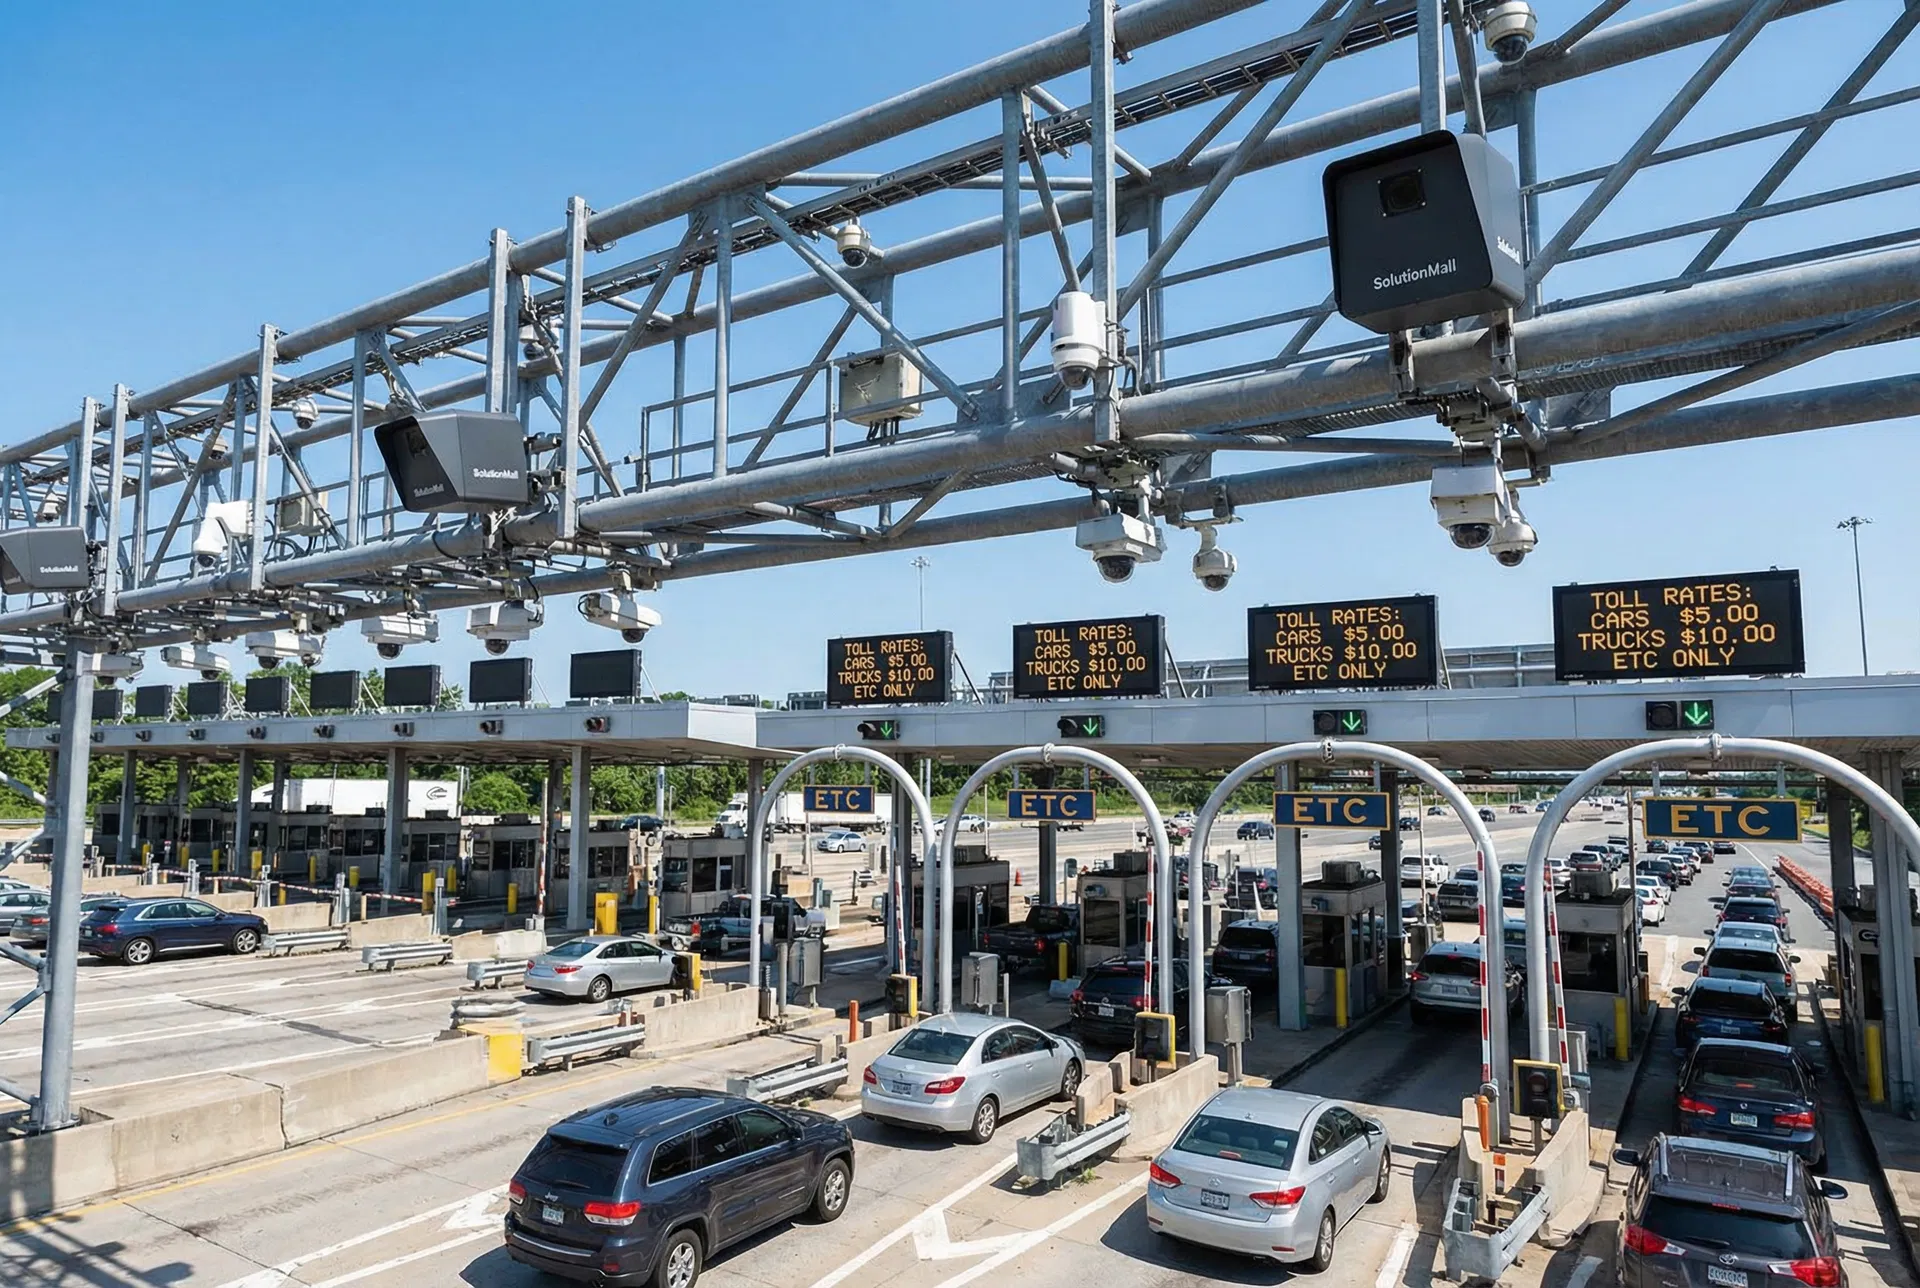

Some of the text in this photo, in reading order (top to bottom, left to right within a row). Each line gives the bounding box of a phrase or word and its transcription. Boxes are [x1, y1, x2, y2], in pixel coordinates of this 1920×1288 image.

[1373, 258, 1456, 290] SolutionMall
[1591, 584, 1751, 609] TOLL RATES:
[1276, 607, 1400, 628] TOLL RATES:
[1591, 604, 1758, 630] CARS $5.00
[1035, 624, 1133, 643] TOLL RATES:
[1276, 624, 1404, 646] CARS $5.00
[1578, 624, 1775, 650] TRUCKS $10.00
[845, 639, 924, 656] TOLL RATES:
[1035, 640, 1136, 659] CARS $5.00
[1266, 642, 1416, 664] TRUCKS $10.00
[1613, 647, 1735, 669] ETC ONLY
[845, 653, 927, 670] CARS $5.00
[1026, 657, 1145, 675] TRUCKS $10.00
[1294, 662, 1386, 681] ETC ONLY
[838, 667, 934, 684] TRUCKS $10.00
[1048, 674, 1121, 690] ETC ONLY
[854, 684, 914, 698] ETC ONLY
[814, 790, 860, 810] ETC
[1021, 795, 1077, 816] ETC
[1293, 798, 1368, 824] ETC
[1670, 804, 1771, 835] ETC
